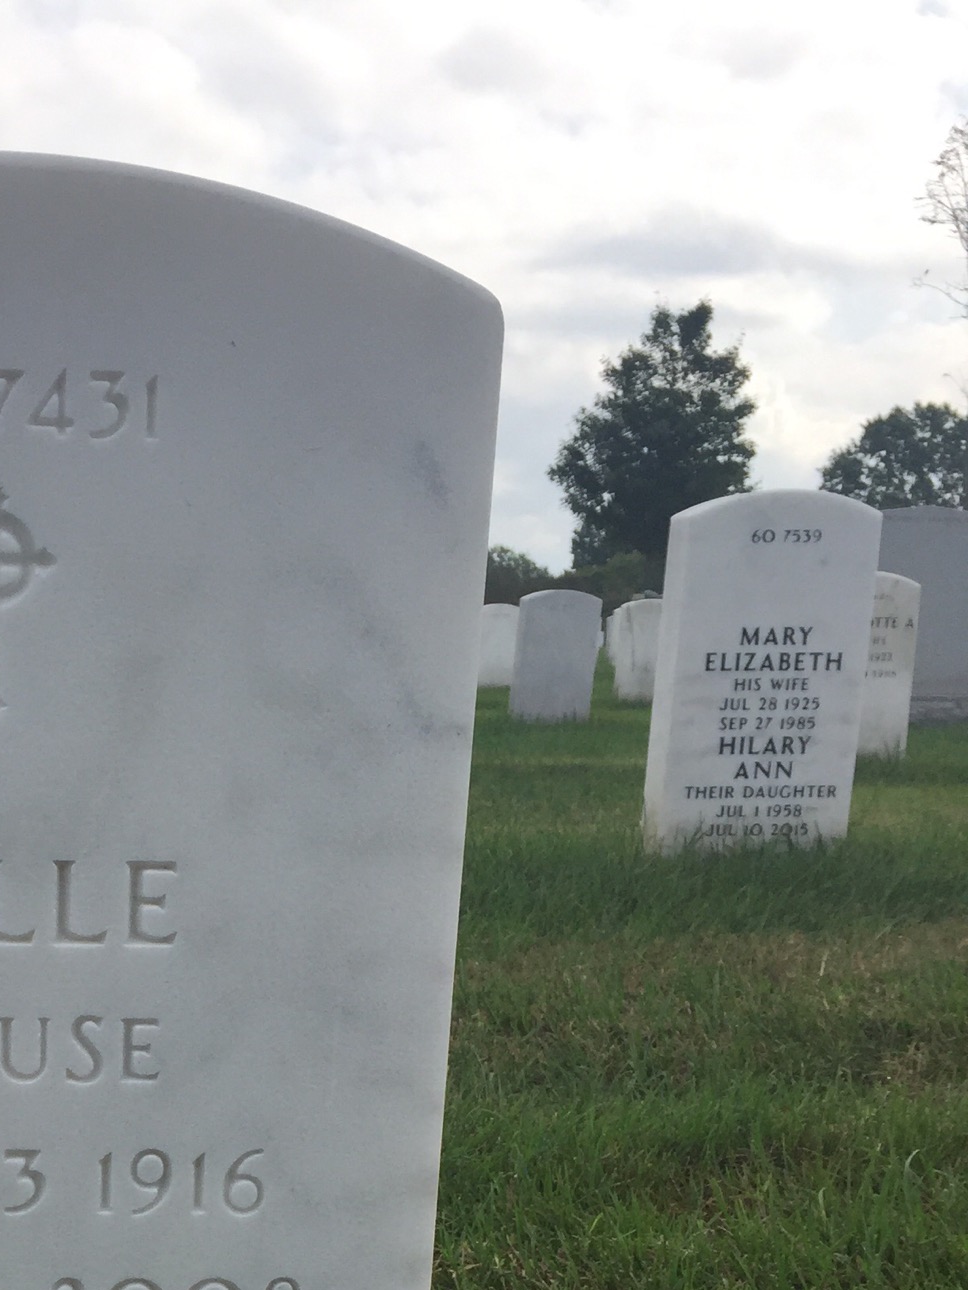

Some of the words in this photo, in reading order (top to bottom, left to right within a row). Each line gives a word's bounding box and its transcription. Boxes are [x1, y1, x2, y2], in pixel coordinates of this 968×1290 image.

[751, 529, 776, 543] 60
[784, 529, 822, 543] 7539
[739, 626, 813, 646] MARY
[705, 652, 843, 672] ELIZABETH
[734, 678, 762, 691] HIS
[770, 678, 809, 691] WIFE
[719, 698, 750, 711] JUL
[759, 697, 777, 710] 28
[784, 697, 820, 710] 1925
[718, 717, 748, 730] SEP
[755, 717, 772, 730] 27
[780, 716, 816, 730] 1985
[718, 736, 812, 755] HILARY
[734, 761, 793, 779] ANN
[685, 786, 734, 799] THEIR
[743, 785, 837, 799] DAUGHTER
[716, 805, 746, 818] JUL
[766, 804, 802, 817] 1958
[705, 823, 736, 837] JUL
[771, 823, 809, 836] 2015
[97, 1148, 265, 1215] 1916
